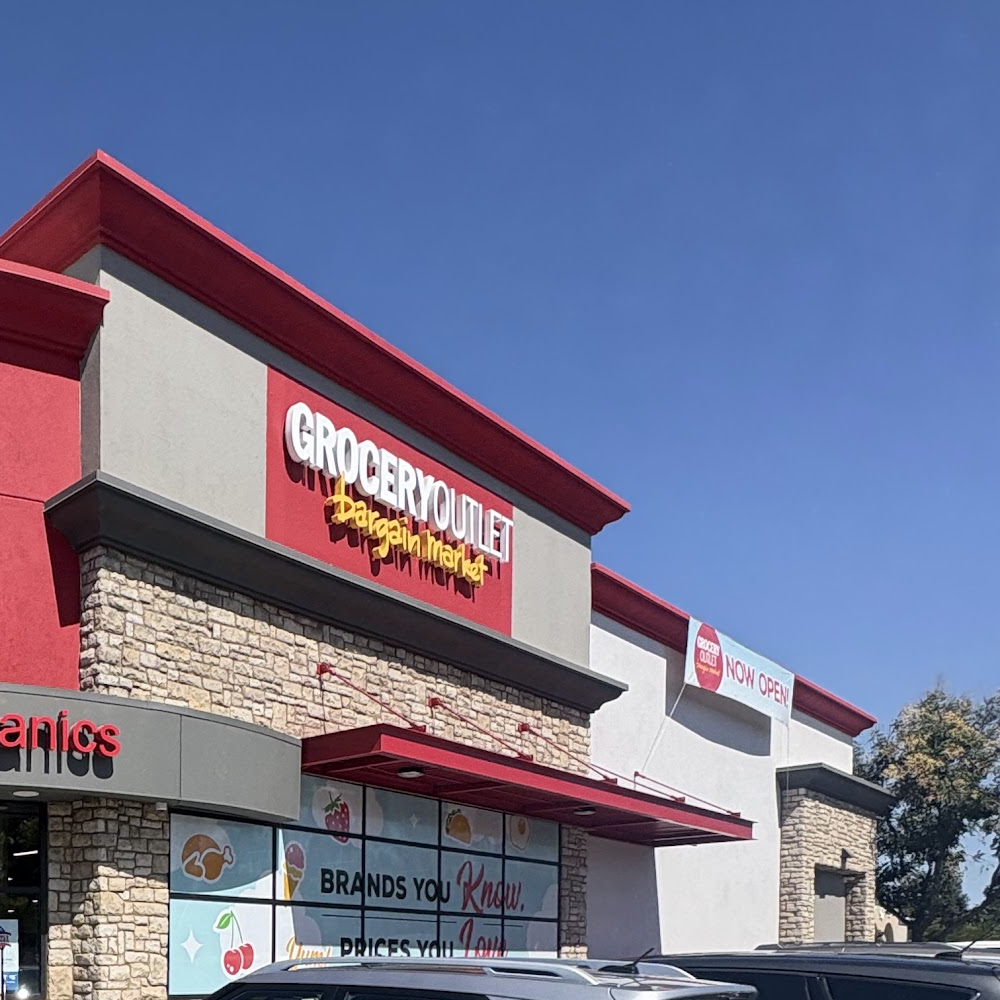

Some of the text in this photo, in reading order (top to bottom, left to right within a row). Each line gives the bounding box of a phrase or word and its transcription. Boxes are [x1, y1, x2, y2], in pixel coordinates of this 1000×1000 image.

[324, 471, 489, 588] bargain market
[725, 653, 756, 690] NOW
[320, 860, 525, 914] BRANDS YOU Know.
[340, 937, 454, 957] PRICES YOU
